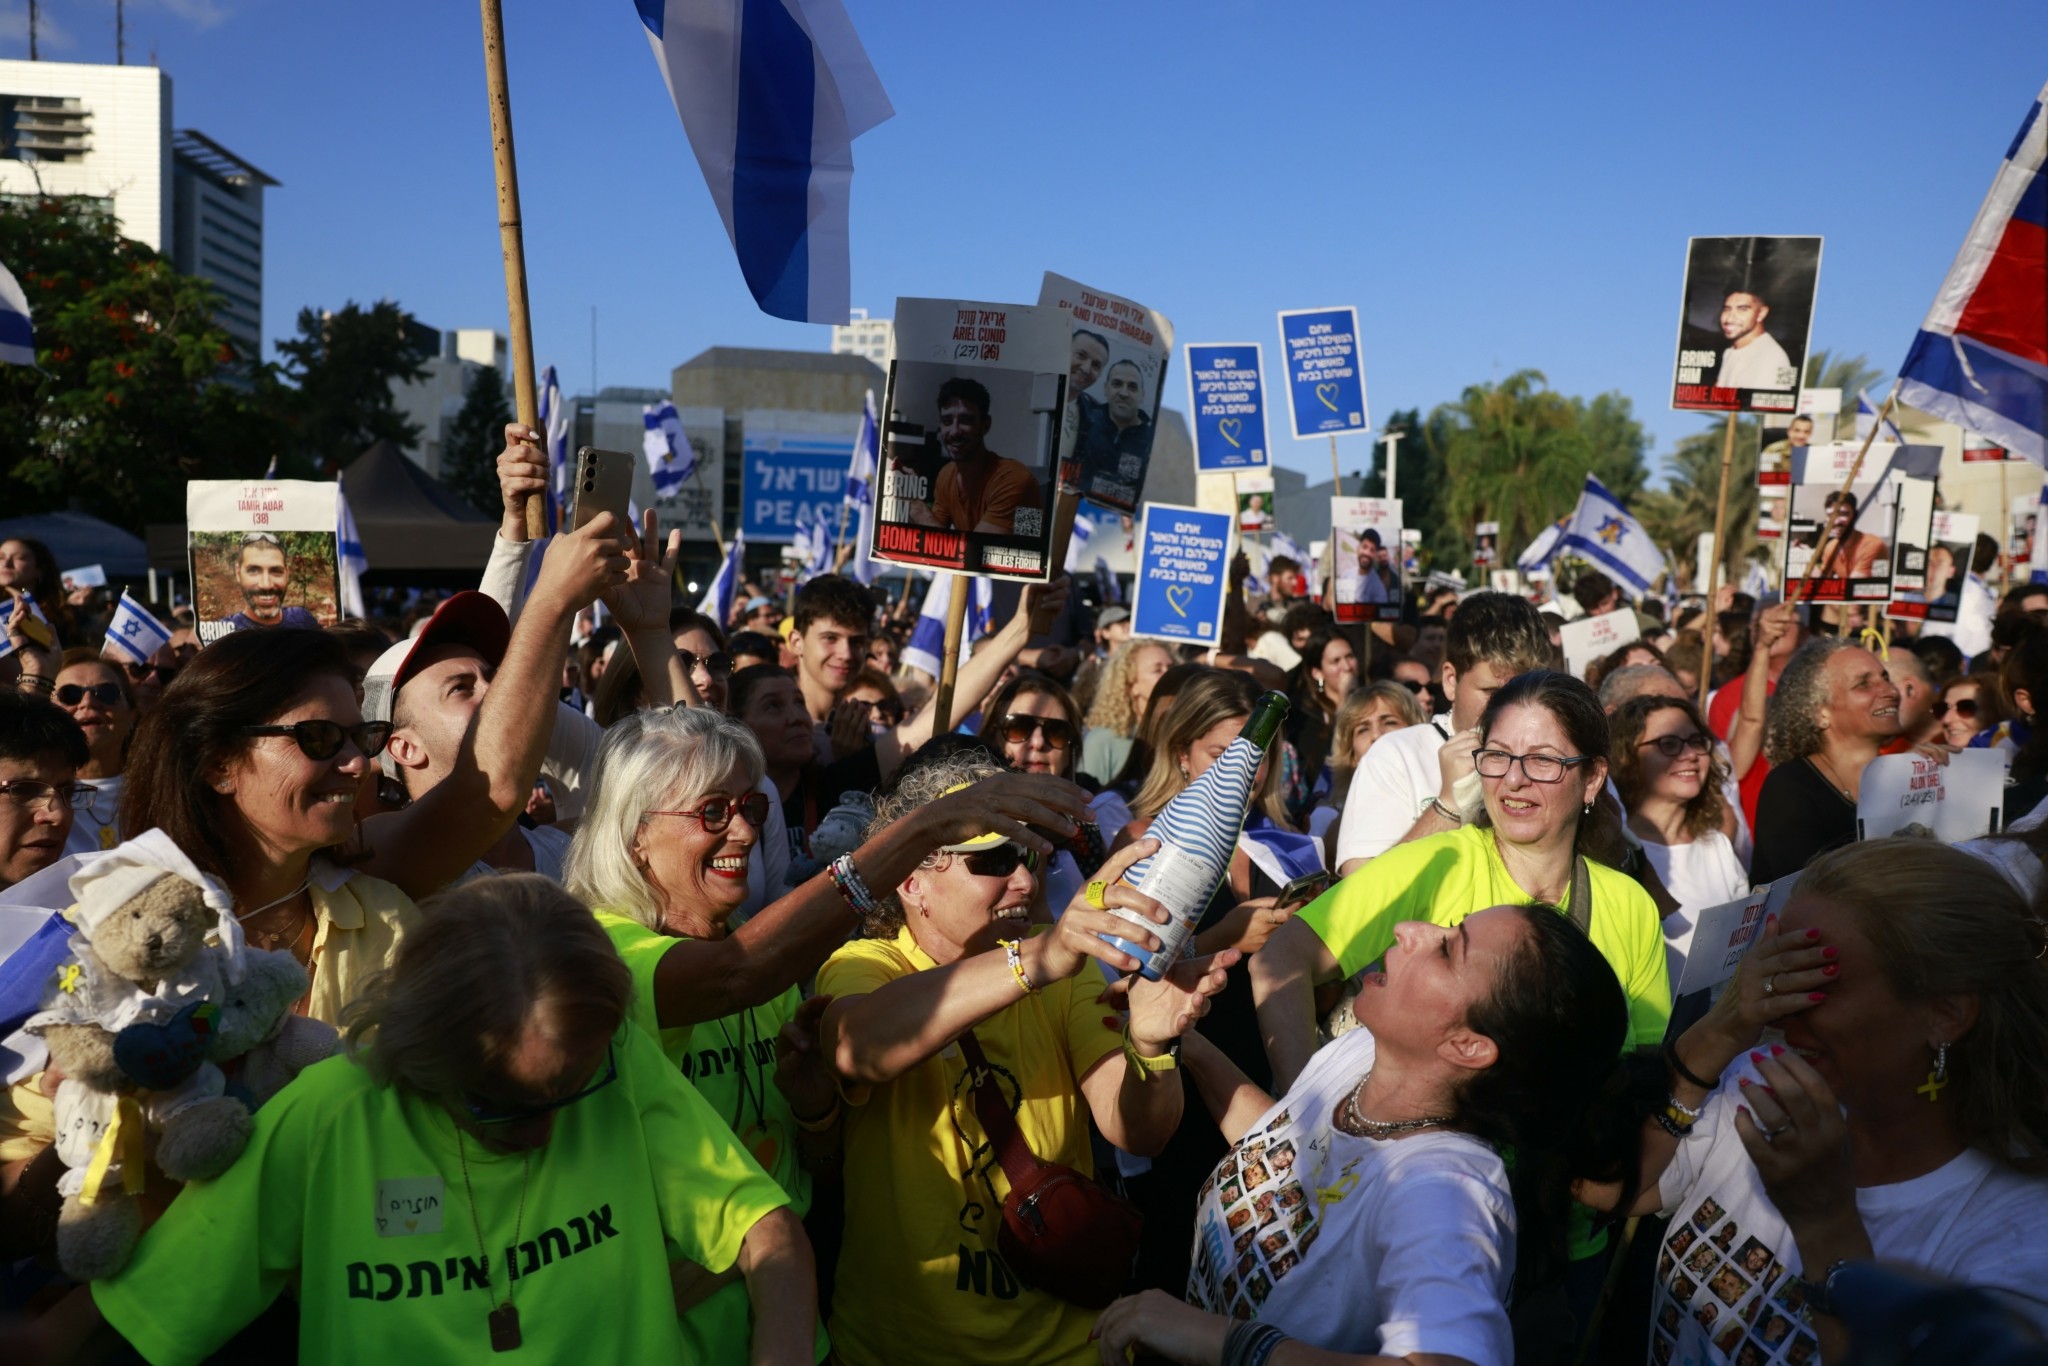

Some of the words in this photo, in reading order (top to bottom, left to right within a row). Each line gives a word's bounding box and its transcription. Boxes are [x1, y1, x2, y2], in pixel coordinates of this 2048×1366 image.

[979, 310, 1006, 327] אריאל
[1131, 308, 1144, 324] אלי
[952, 326, 976, 341] ARIEL
[978, 327, 1006, 343] CUNIO
[1073, 306, 1091, 322] AND
[1093, 312, 1118, 330] YOSSI
[1119, 321, 1154, 346] SHARABI
[1308, 323, 1332, 335] אתם
[954, 344, 979, 360] (27)
[1680, 350, 1716, 367] BRING
[1213, 358, 1237, 369] אתם
[1297, 370, 1322, 382] בבית
[1678, 367, 1702, 384] HIM
[1676, 384, 1708, 402] HOME
[1202, 404, 1225, 415] בבית
[755, 460, 850, 492] שראל
[883, 470, 928, 500] BRING
[238, 500, 260, 511] TAMIR
[262, 500, 284, 511] ADAR
[755, 499, 850, 527] PEACE
[881, 497, 911, 524] HIM
[253, 512, 269, 525] (38)
[1174, 522, 1201, 534] אתם
[879, 524, 921, 553] HOME
[923, 531, 967, 560] NOW!
[982, 553, 1014, 568] FAMILIES
[1014, 556, 1041, 571] FORUM
[1149, 567, 1177, 581] בבית
[506, 1204, 620, 1281] אנחנו
[346, 1254, 490, 1302] איתכם
